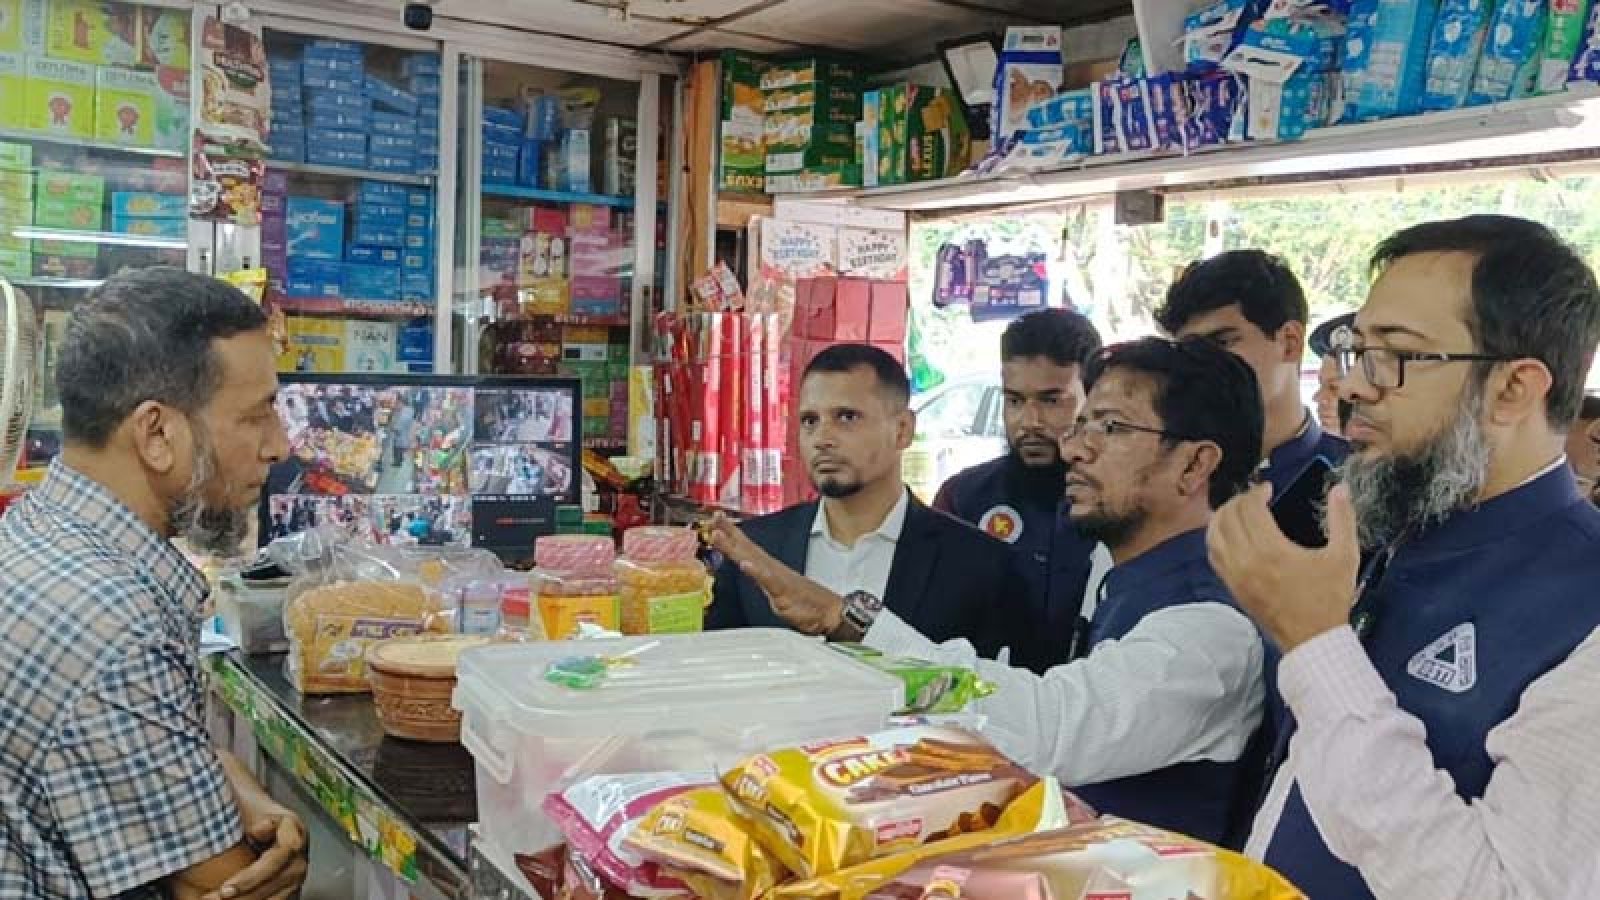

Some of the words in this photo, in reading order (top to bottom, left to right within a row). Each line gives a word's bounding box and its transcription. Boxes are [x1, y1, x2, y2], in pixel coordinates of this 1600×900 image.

[725, 172, 763, 188] EXUS
[779, 237, 812, 248] HAPPY
[857, 242, 889, 254] HAPPY
[773, 248, 819, 259] BIRTHDAY
[849, 252, 897, 268] BIRTHDAY
